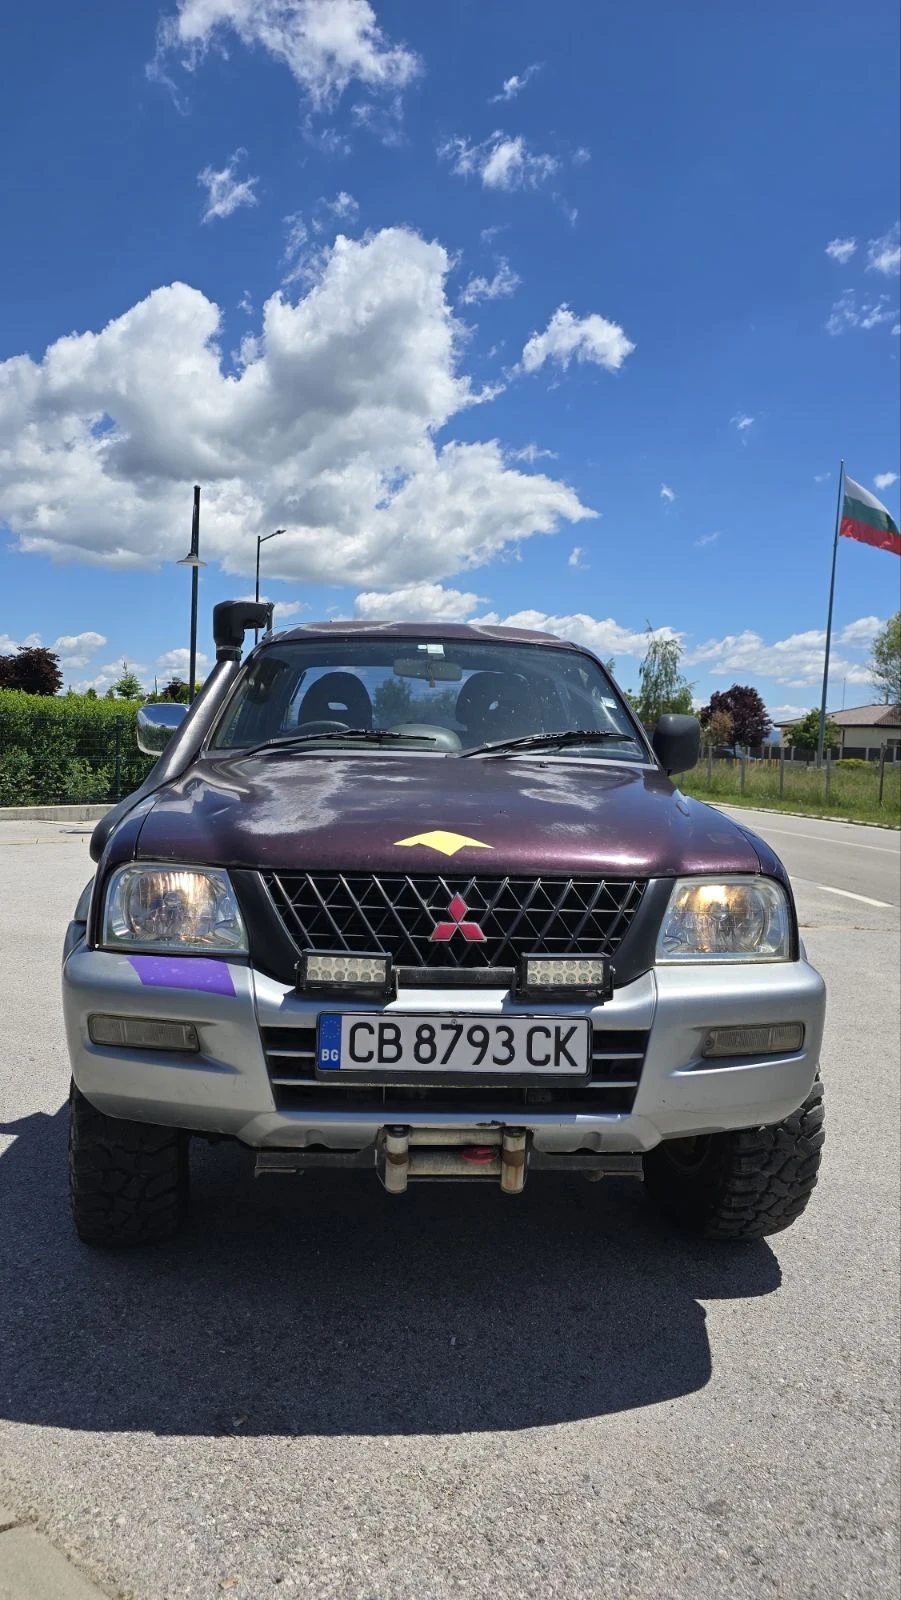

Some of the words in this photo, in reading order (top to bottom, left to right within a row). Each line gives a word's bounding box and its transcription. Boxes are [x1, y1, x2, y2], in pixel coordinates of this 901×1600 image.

[321, 1049, 339, 1061] BG
[349, 1021, 403, 1064] CB
[413, 1023, 516, 1066] 8793
[526, 1025, 578, 1067] CK
